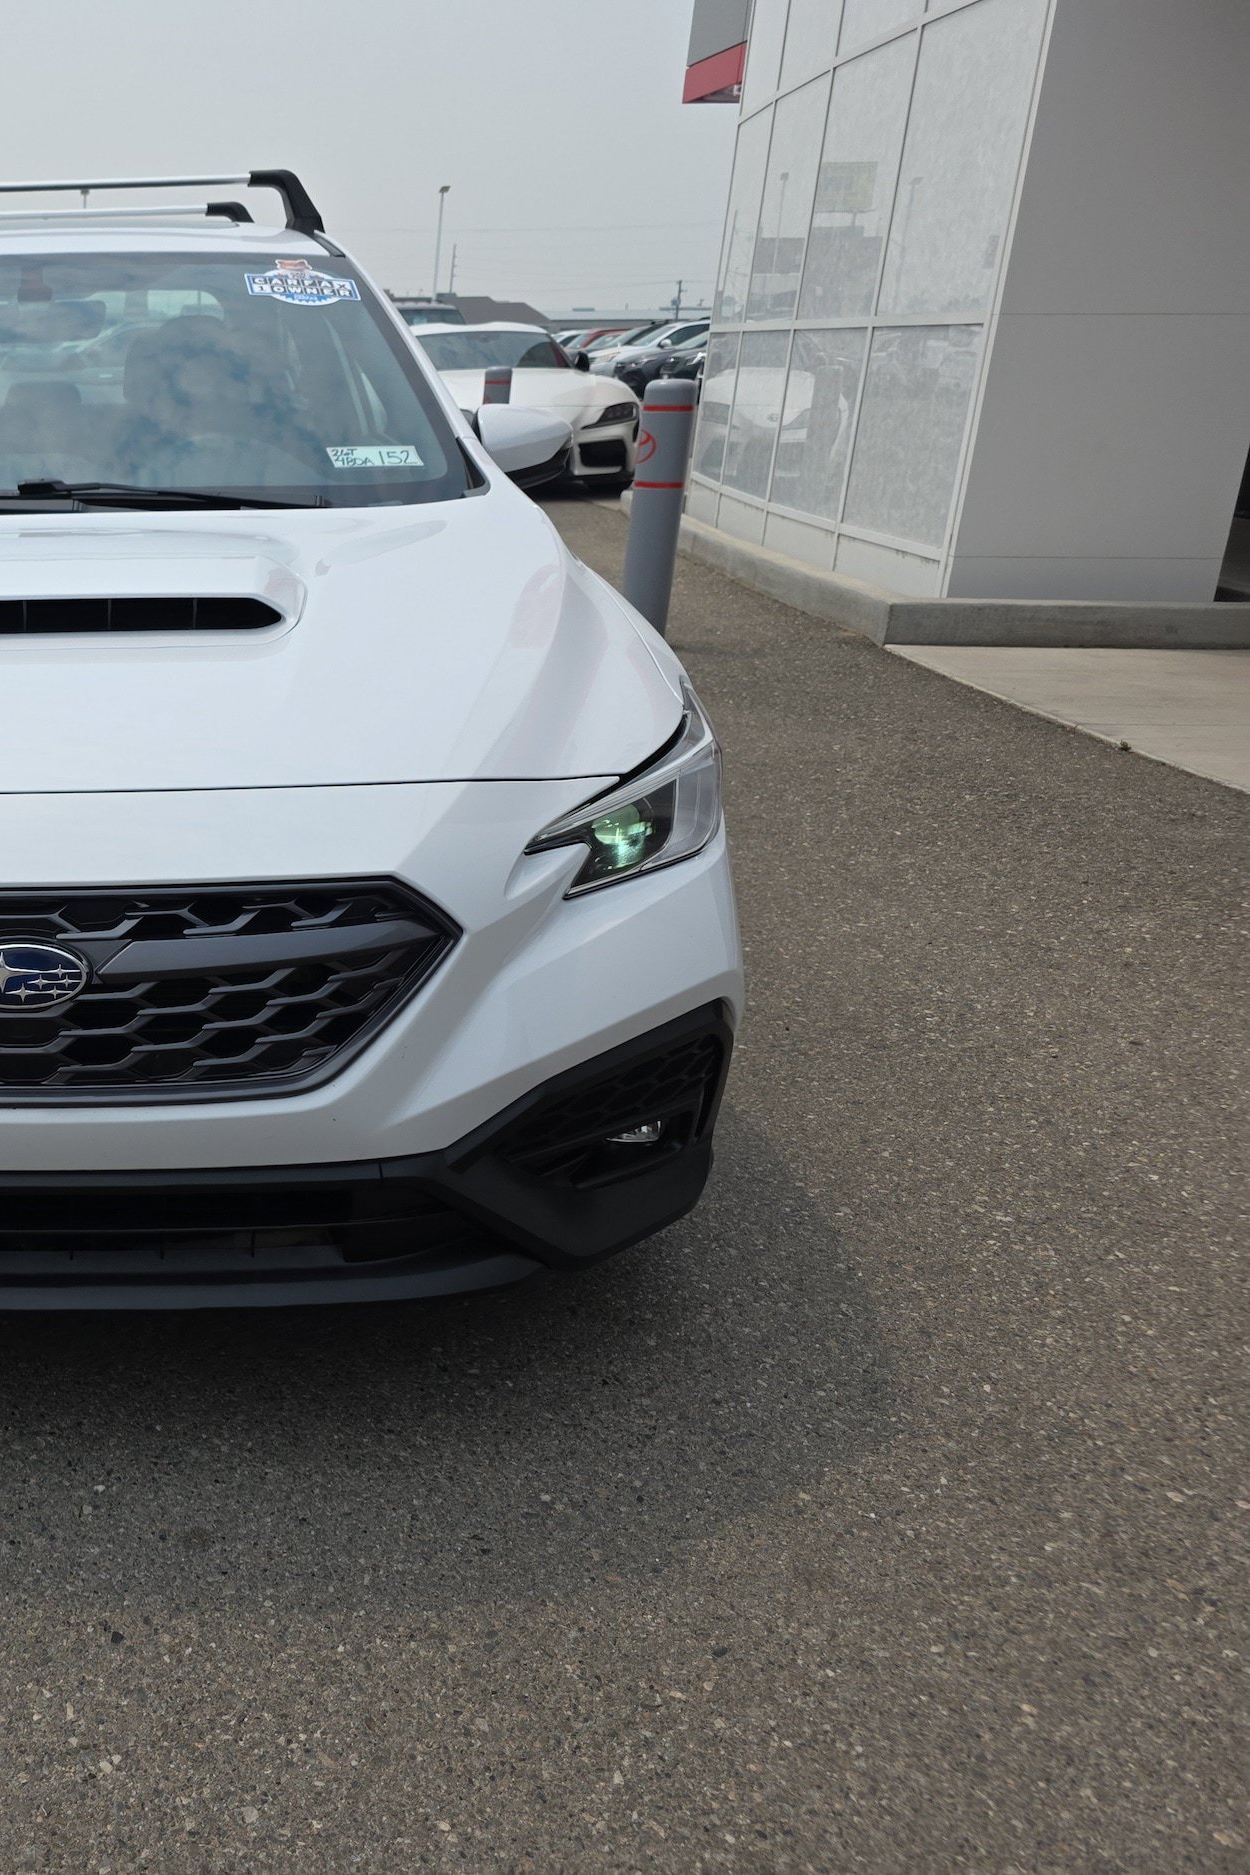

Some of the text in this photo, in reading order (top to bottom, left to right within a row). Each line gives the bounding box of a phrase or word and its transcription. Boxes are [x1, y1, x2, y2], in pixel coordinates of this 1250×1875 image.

[254, 277, 349, 290] CARFAX
[273, 286, 351, 297] OWNER
[378, 449, 419, 465] 152
